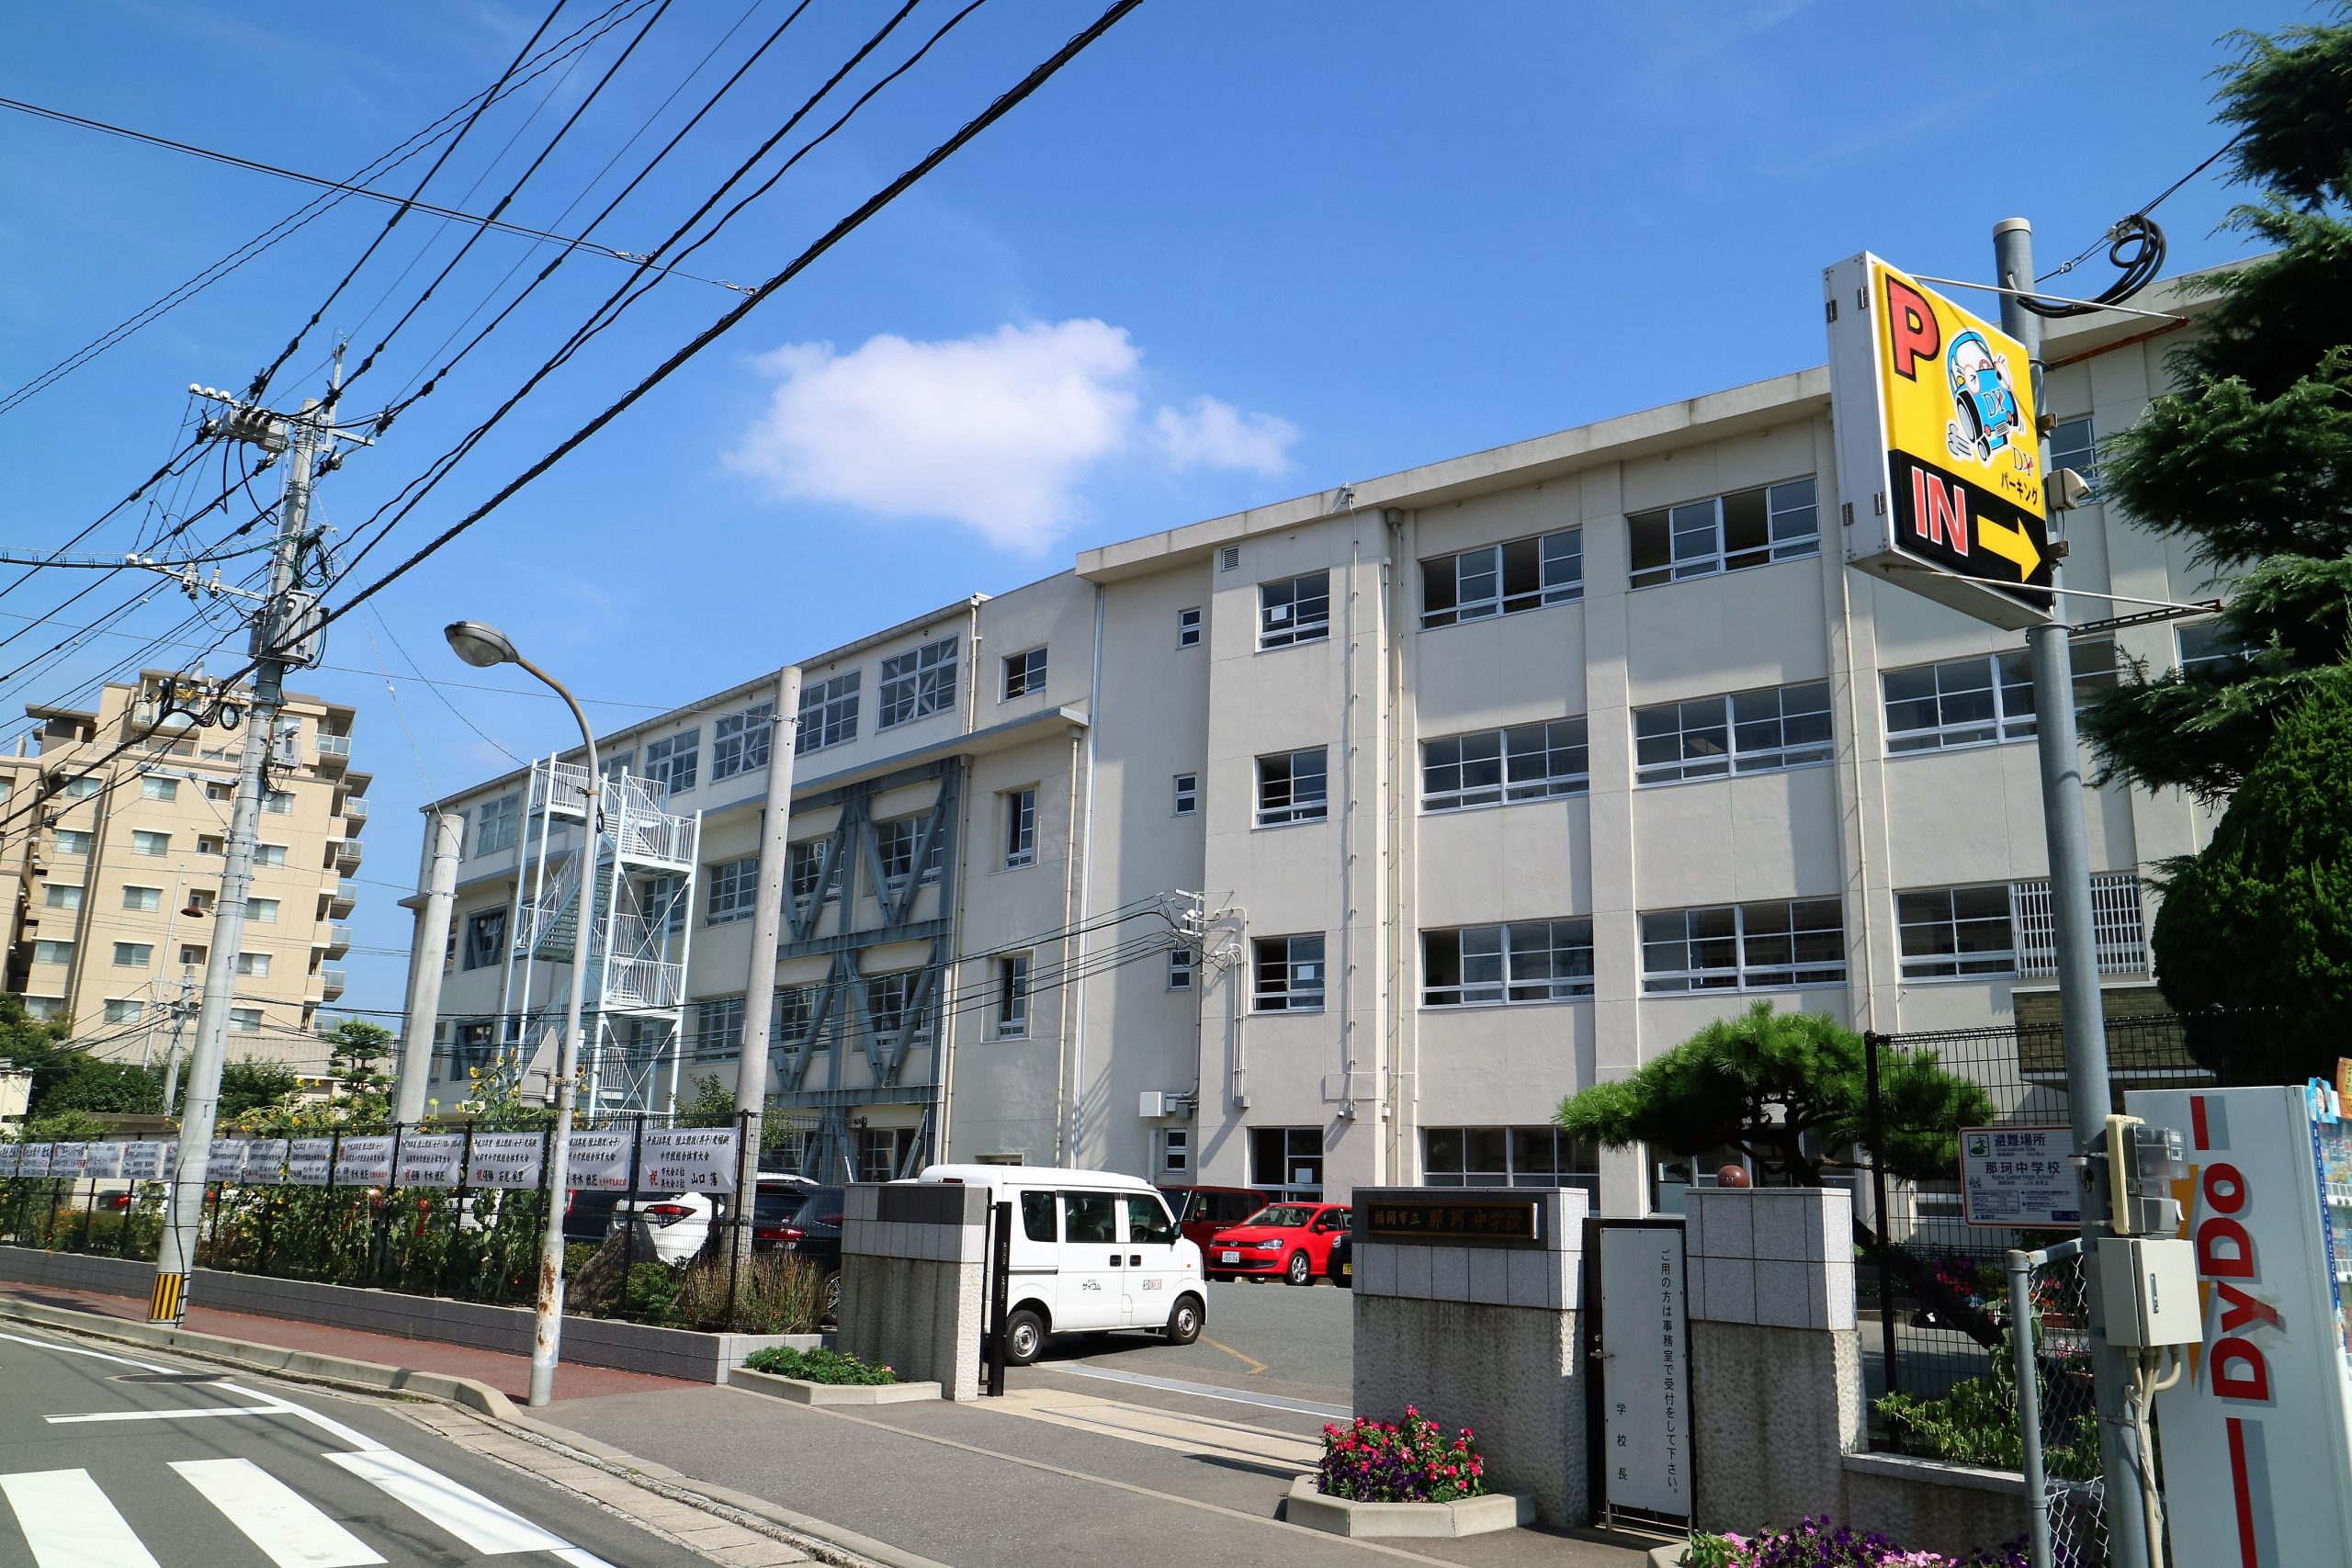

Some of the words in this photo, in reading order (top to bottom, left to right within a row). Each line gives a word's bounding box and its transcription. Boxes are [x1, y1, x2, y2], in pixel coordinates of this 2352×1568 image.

[1885, 273, 1940, 382] P
[2001, 471, 2038, 505] パーキング
[2012, 446, 2034, 477] DY
[1911, 465, 1969, 557] IN
[1984, 1161, 2061, 1174] 那珂中学校
[1994, 1133, 2045, 1147] 避難場所
[2197, 1162, 2278, 1401] DyDo
[1660, 1249, 1678, 1495] ご用の方は事務室で受付をして下さい。
[1615, 1403, 1628, 1482] 学校長
